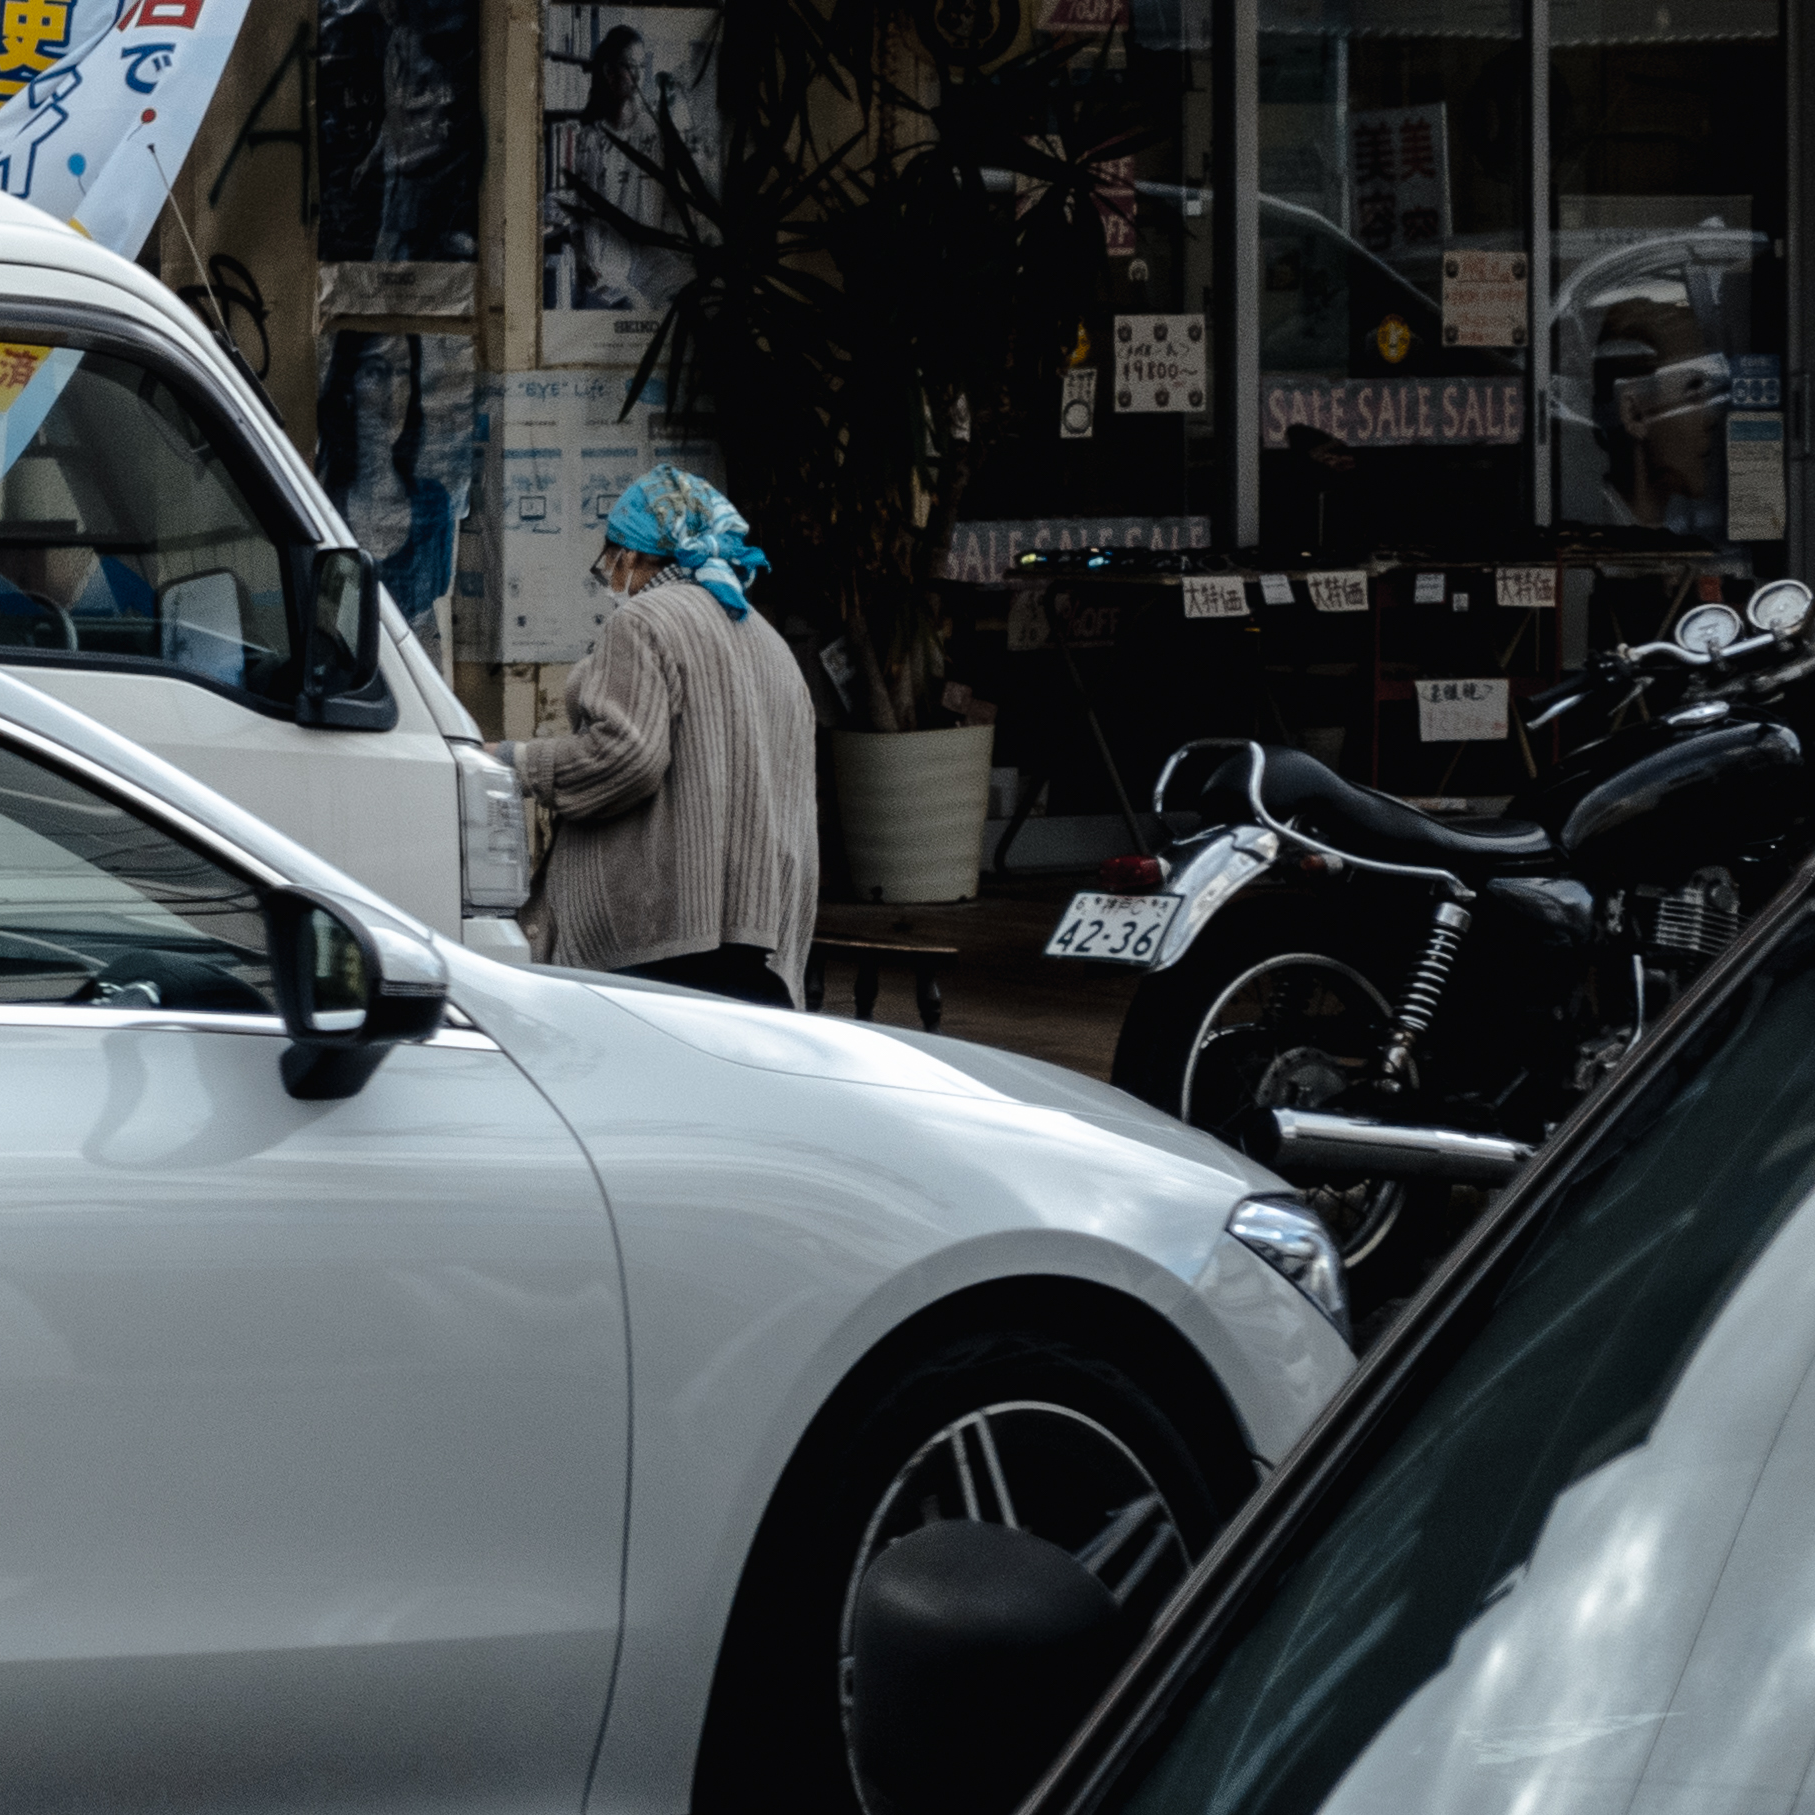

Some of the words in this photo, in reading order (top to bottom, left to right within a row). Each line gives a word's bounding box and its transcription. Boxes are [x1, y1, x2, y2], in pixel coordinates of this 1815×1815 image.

[1357, 385, 1431, 439] SALE
[1441, 385, 1518, 439] SALE
[1056, 918, 1161, 957] 42-36
